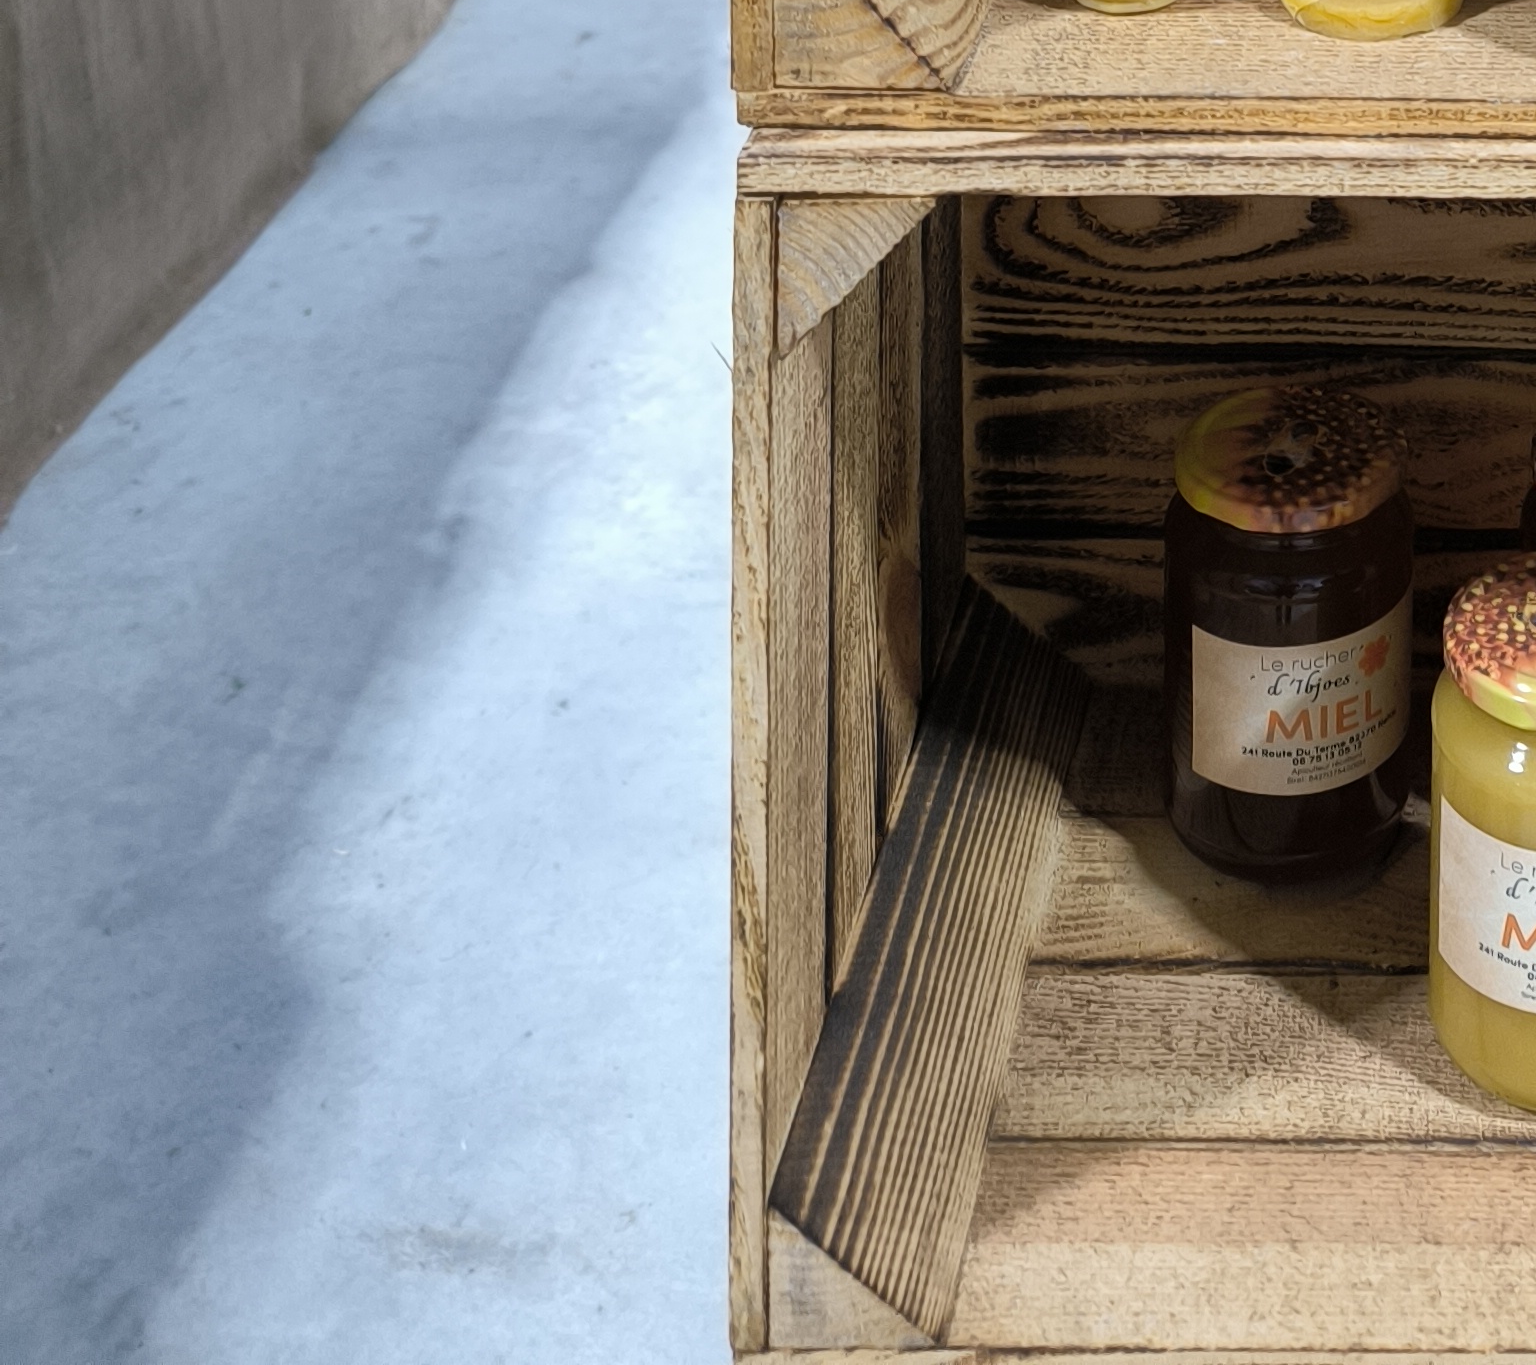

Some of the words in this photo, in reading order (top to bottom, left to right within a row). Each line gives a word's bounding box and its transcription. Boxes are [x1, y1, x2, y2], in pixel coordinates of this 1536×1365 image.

[1260, 655, 1283, 672] Le
[1292, 647, 1357, 671] rucher
[1265, 690, 1382, 743] MIEL
[1241, 746, 1258, 757] 241
[1261, 748, 1292, 758] Route
[1296, 748, 1311, 757] Du
[1500, 851, 1523, 874] Le
[1479, 942, 1494, 957] 241
[1497, 951, 1528, 970] Route
